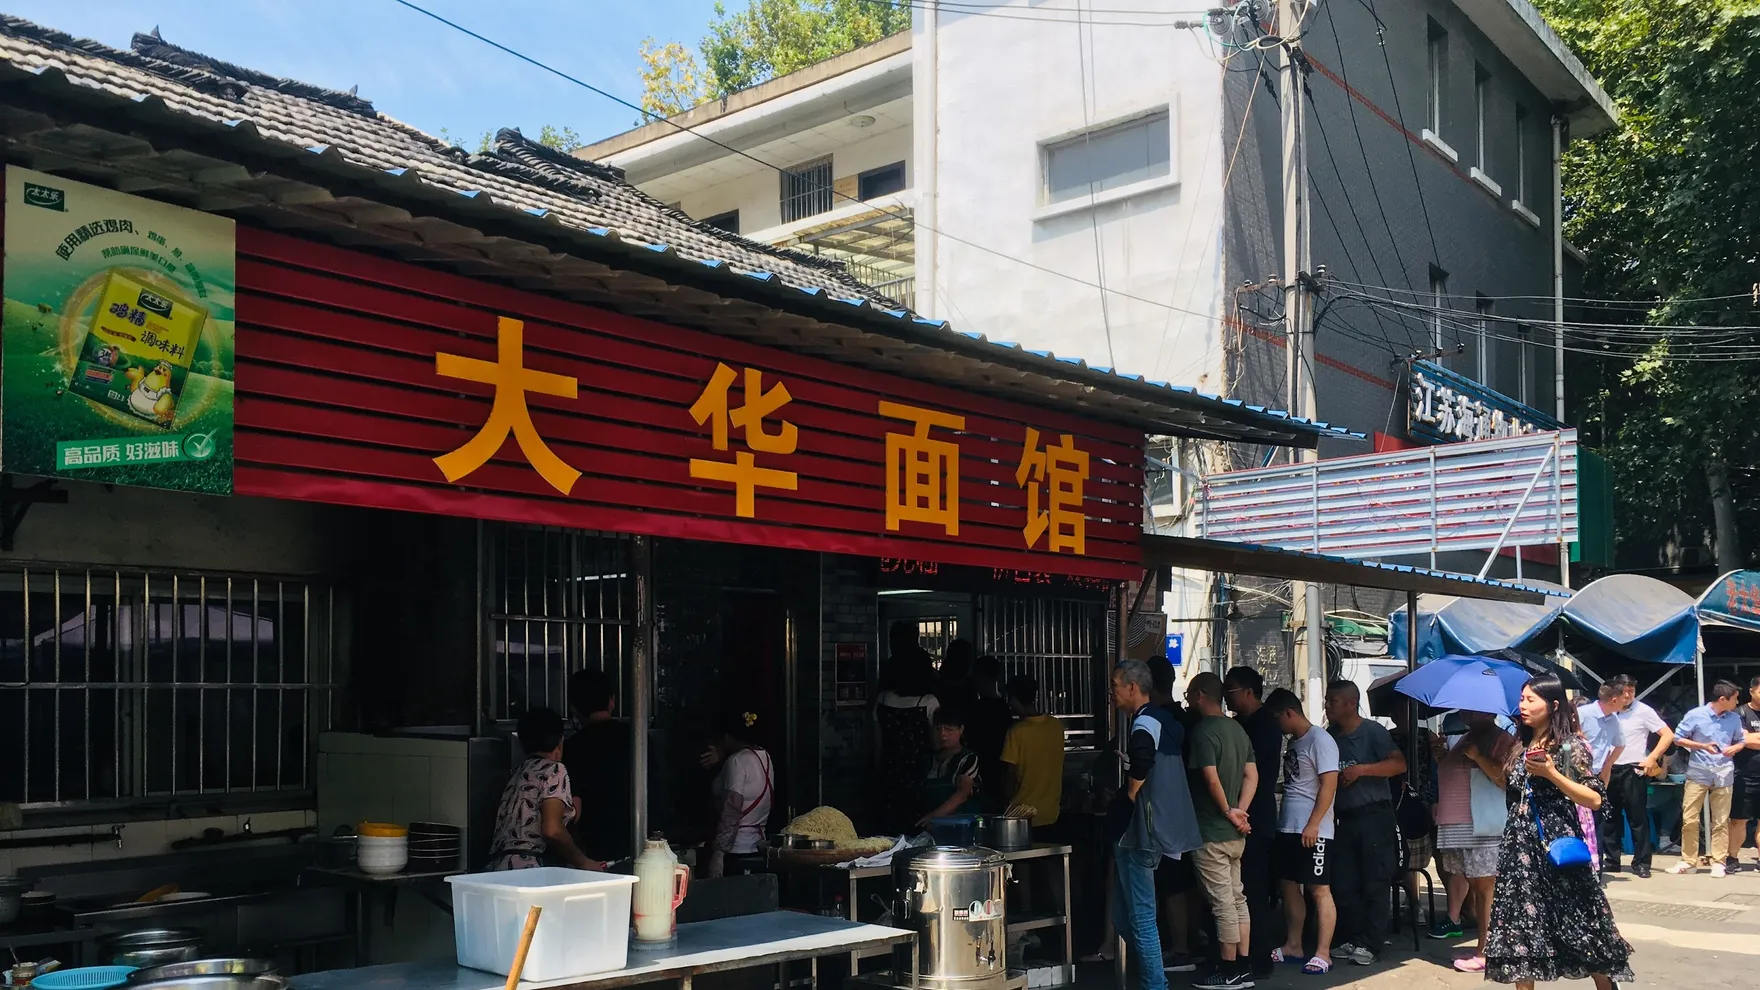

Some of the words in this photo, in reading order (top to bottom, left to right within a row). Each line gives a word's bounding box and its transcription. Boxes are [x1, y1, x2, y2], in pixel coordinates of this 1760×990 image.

[31, 187, 59, 201] 太太乐
[144, 293, 169, 309] 太太乐
[109, 303, 147, 327] 鸡精
[140, 330, 186, 359] 调味料
[433, 316, 1090, 555] 大华面馆
[64, 444, 120, 465] 高品质
[126, 441, 179, 461] 好滋味
[1313, 836, 1326, 876] adida
